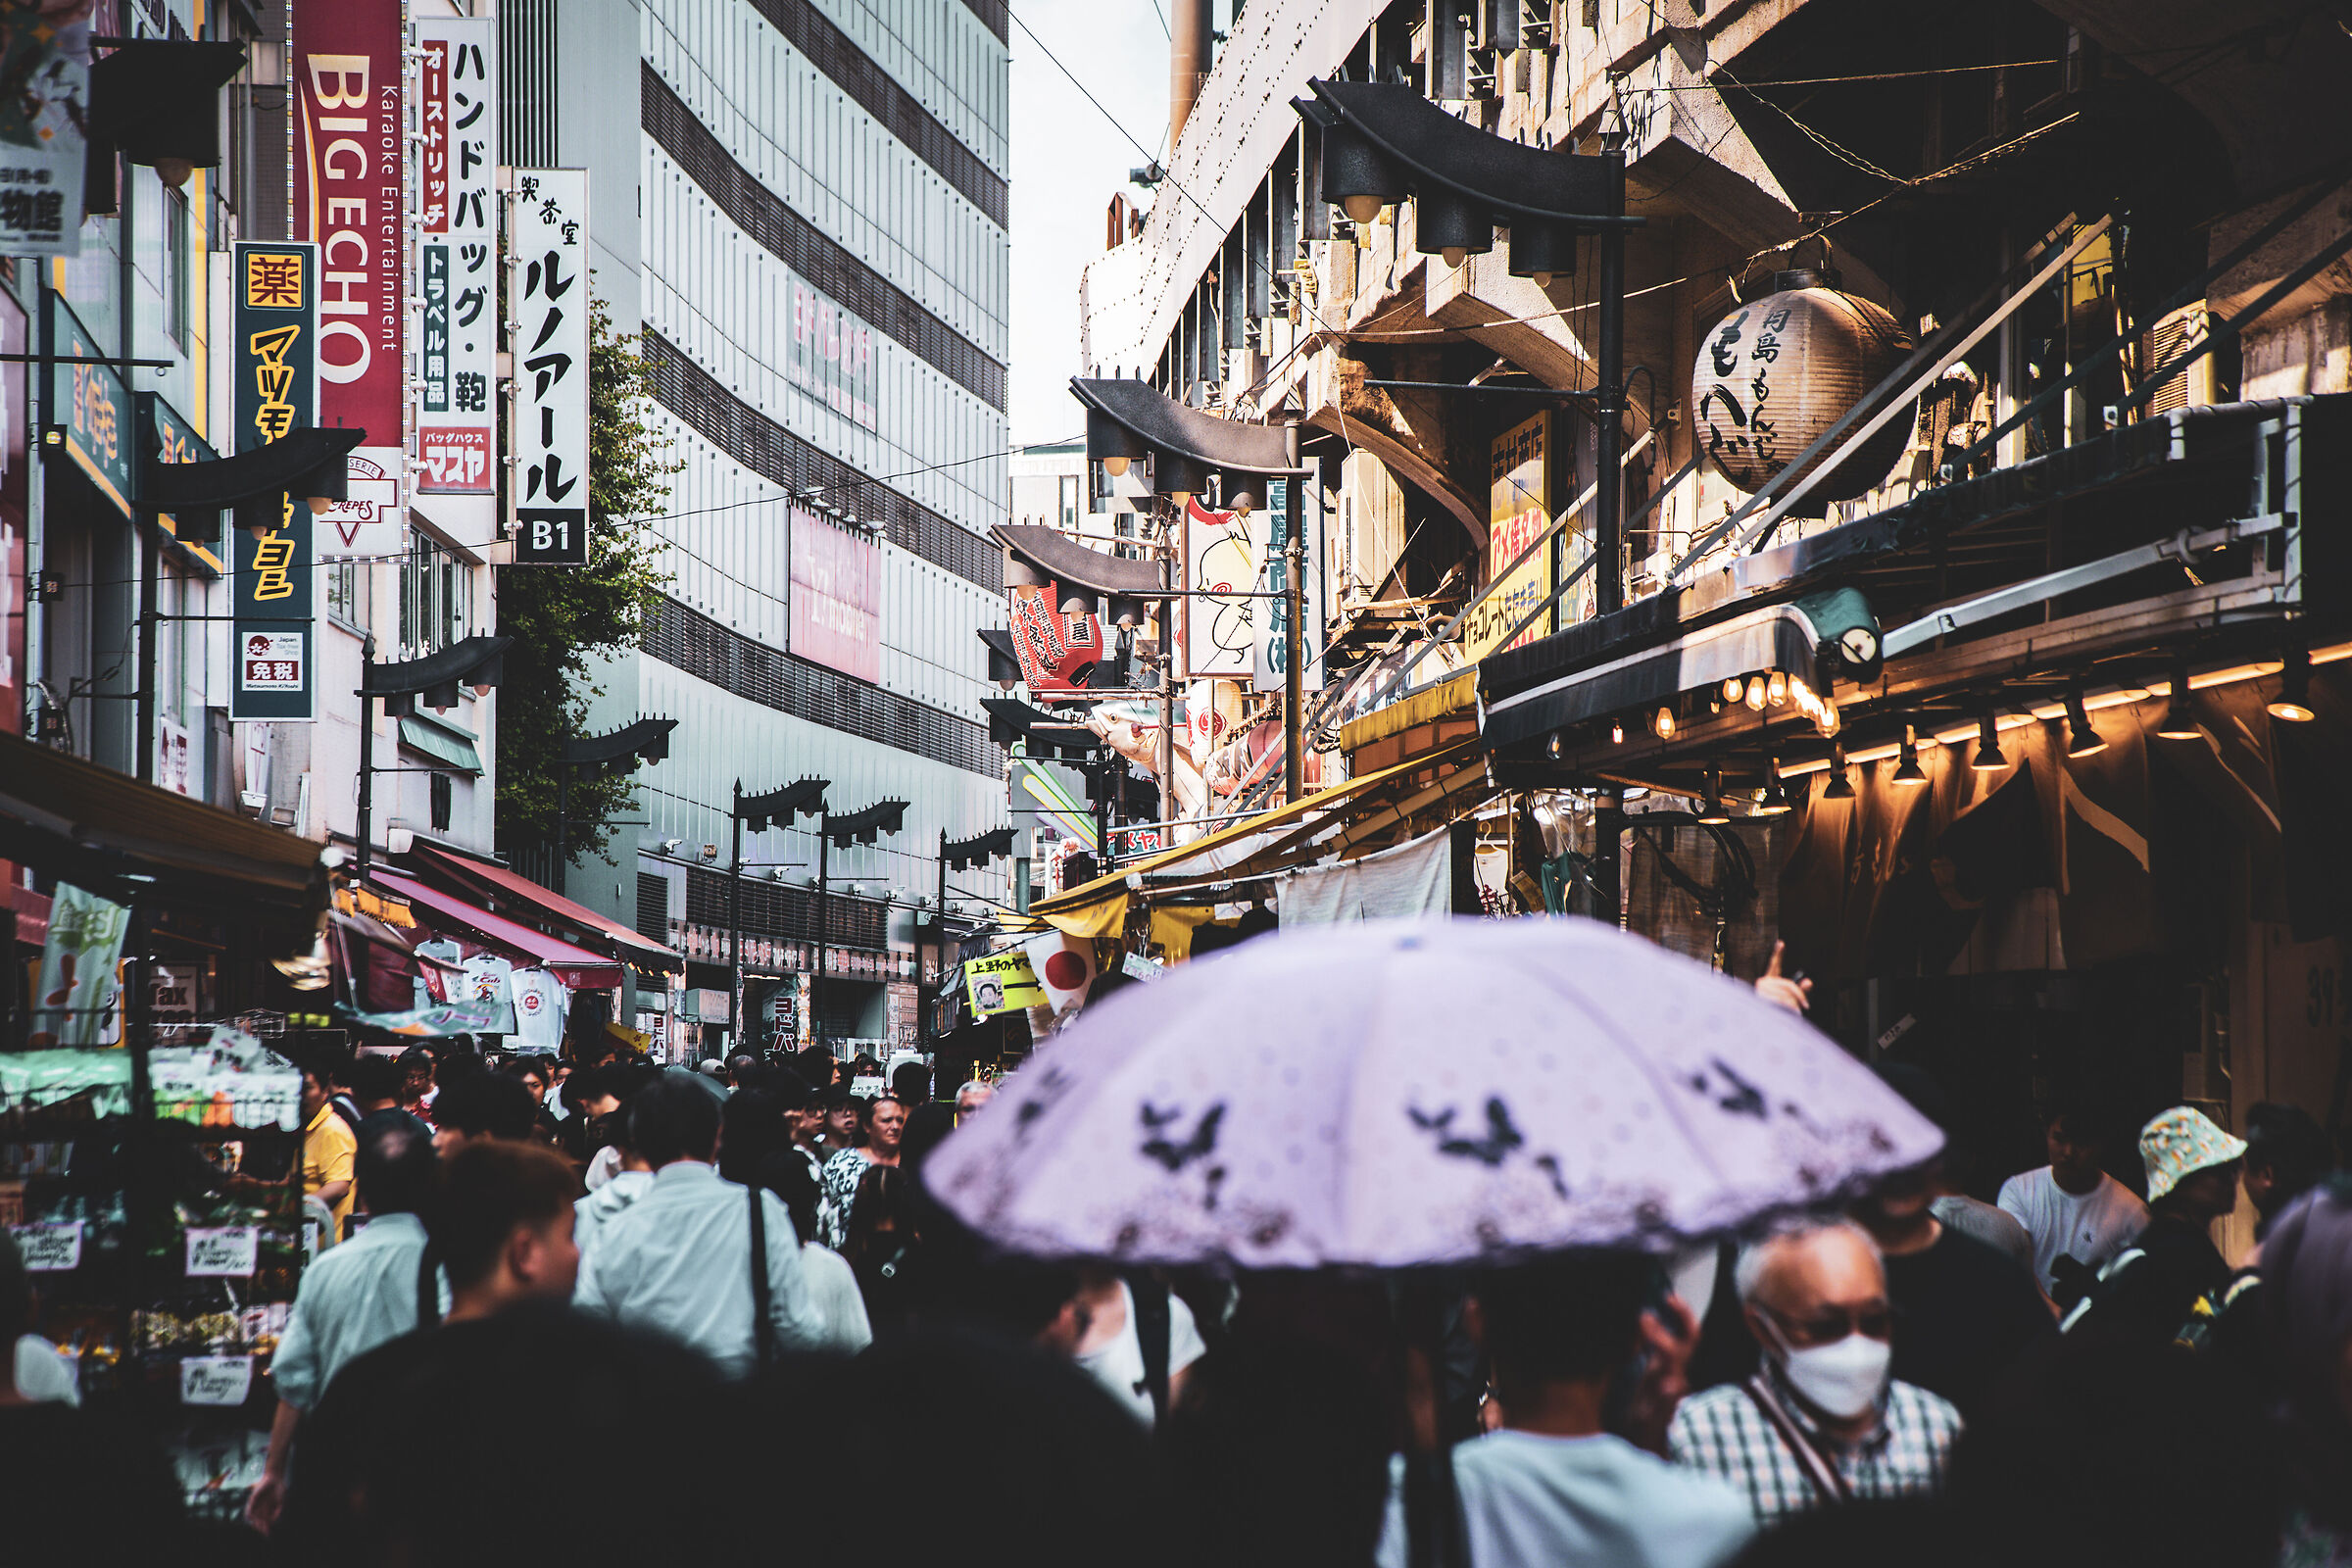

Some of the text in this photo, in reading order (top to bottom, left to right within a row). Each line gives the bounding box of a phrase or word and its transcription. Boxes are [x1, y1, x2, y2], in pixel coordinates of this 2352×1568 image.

[251, 258, 299, 305] 薬
[307, 54, 371, 384] BIG ECHO
[381, 85, 399, 351] Karaoke Entertainment
[454, 43, 488, 412] ハンドバッグ・鞄
[250, 324, 301, 602] マツモヨシ
[425, 432, 483, 443] バッグハウス
[523, 250, 579, 503] ルノアール
[1699, 311, 1749, 485] もへじ
[425, 446, 485, 483] マスヤ
[532, 520, 568, 550] B1
[252, 662, 294, 680] 免税
